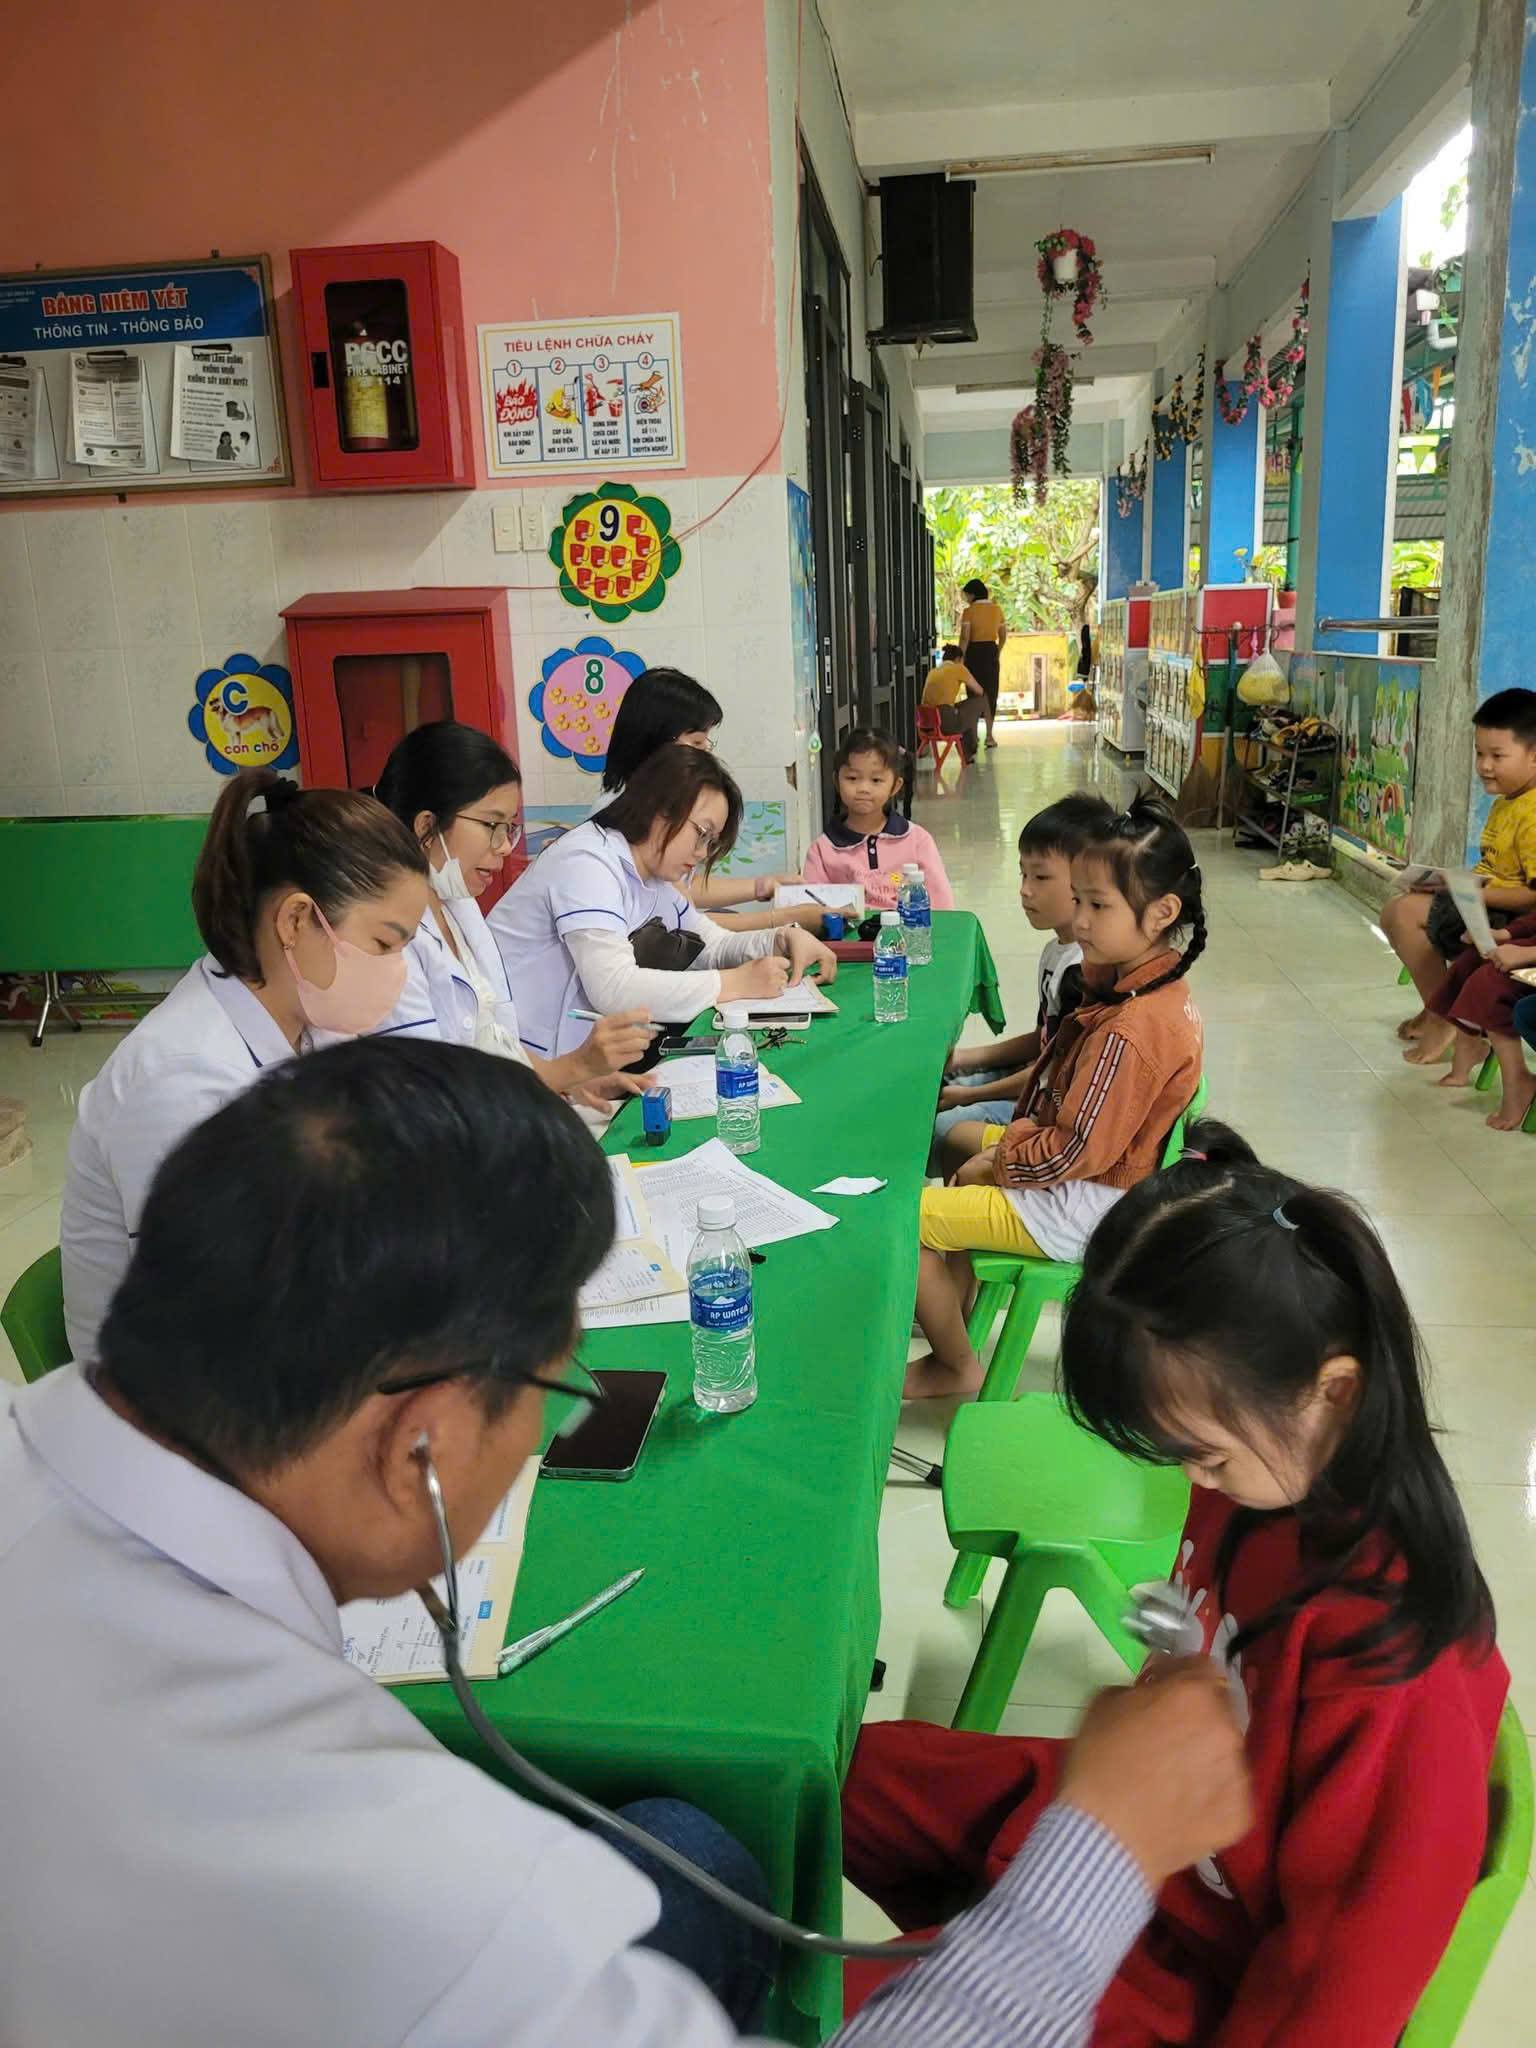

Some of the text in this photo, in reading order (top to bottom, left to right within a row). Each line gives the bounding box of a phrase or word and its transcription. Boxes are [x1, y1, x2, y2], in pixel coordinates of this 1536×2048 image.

[100, 288, 150, 313] NIÊM
[152, 281, 188, 309] YẾT
[34, 323, 82, 339] THÔNG
[85, 323, 109, 336] TIN
[120, 317, 170, 334] THÔNG
[537, 336, 572, 353] LỆNH
[575, 334, 613, 348] CHỮA
[511, 363, 517, 374] 1
[554, 360, 561, 371] 2
[598, 357, 605, 369] 3
[641, 355, 649, 366] 4
[370, 363, 408, 376] CABINET
[600, 505, 619, 541] 9
[585, 659, 604, 694] 8
[222, 681, 248, 714] C
[224, 740, 279, 755] con chó
